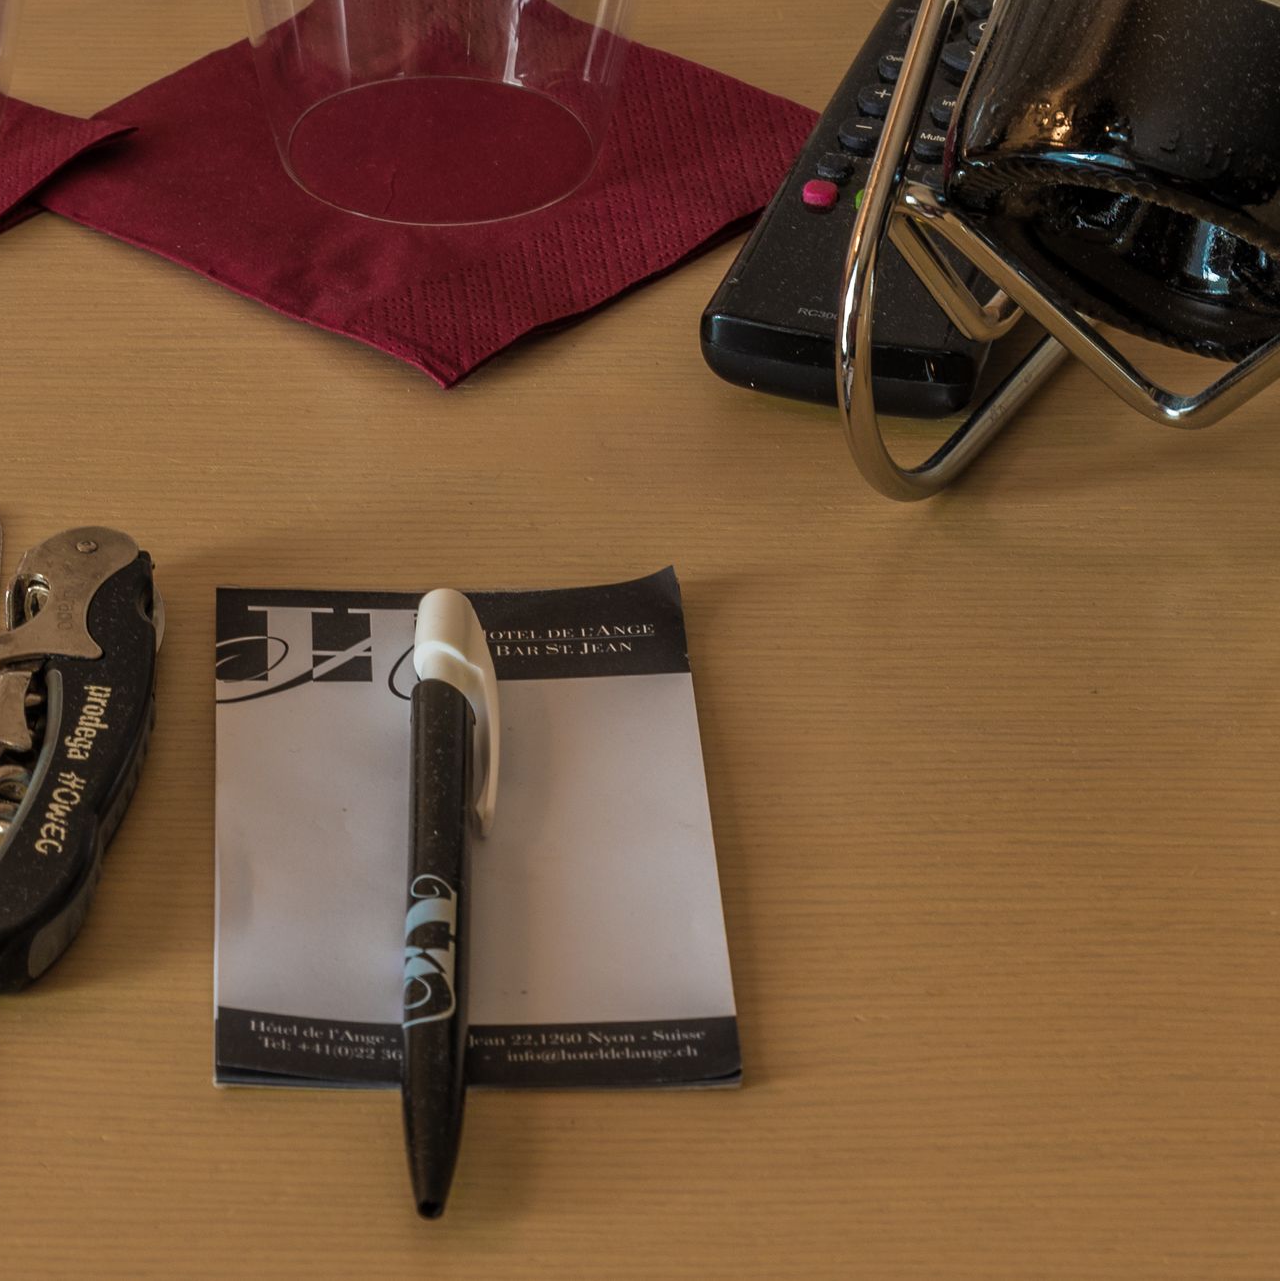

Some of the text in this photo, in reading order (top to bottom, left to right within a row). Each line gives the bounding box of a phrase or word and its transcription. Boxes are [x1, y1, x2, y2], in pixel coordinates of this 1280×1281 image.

[920, 132, 946, 142] Mute
[484, 624, 656, 640] OTEL DE L'ANGE
[496, 644, 539, 657] BAR
[579, 641, 633, 655] JEAN
[35, 684, 111, 855] prodega HOWEG
[250, 1020, 298, 1036] Hôtel
[302, 1026, 323, 1038] de
[329, 1028, 385, 1045] l'Ange
[588, 1030, 635, 1046] Nyon
[652, 1028, 706, 1041] Suisse
